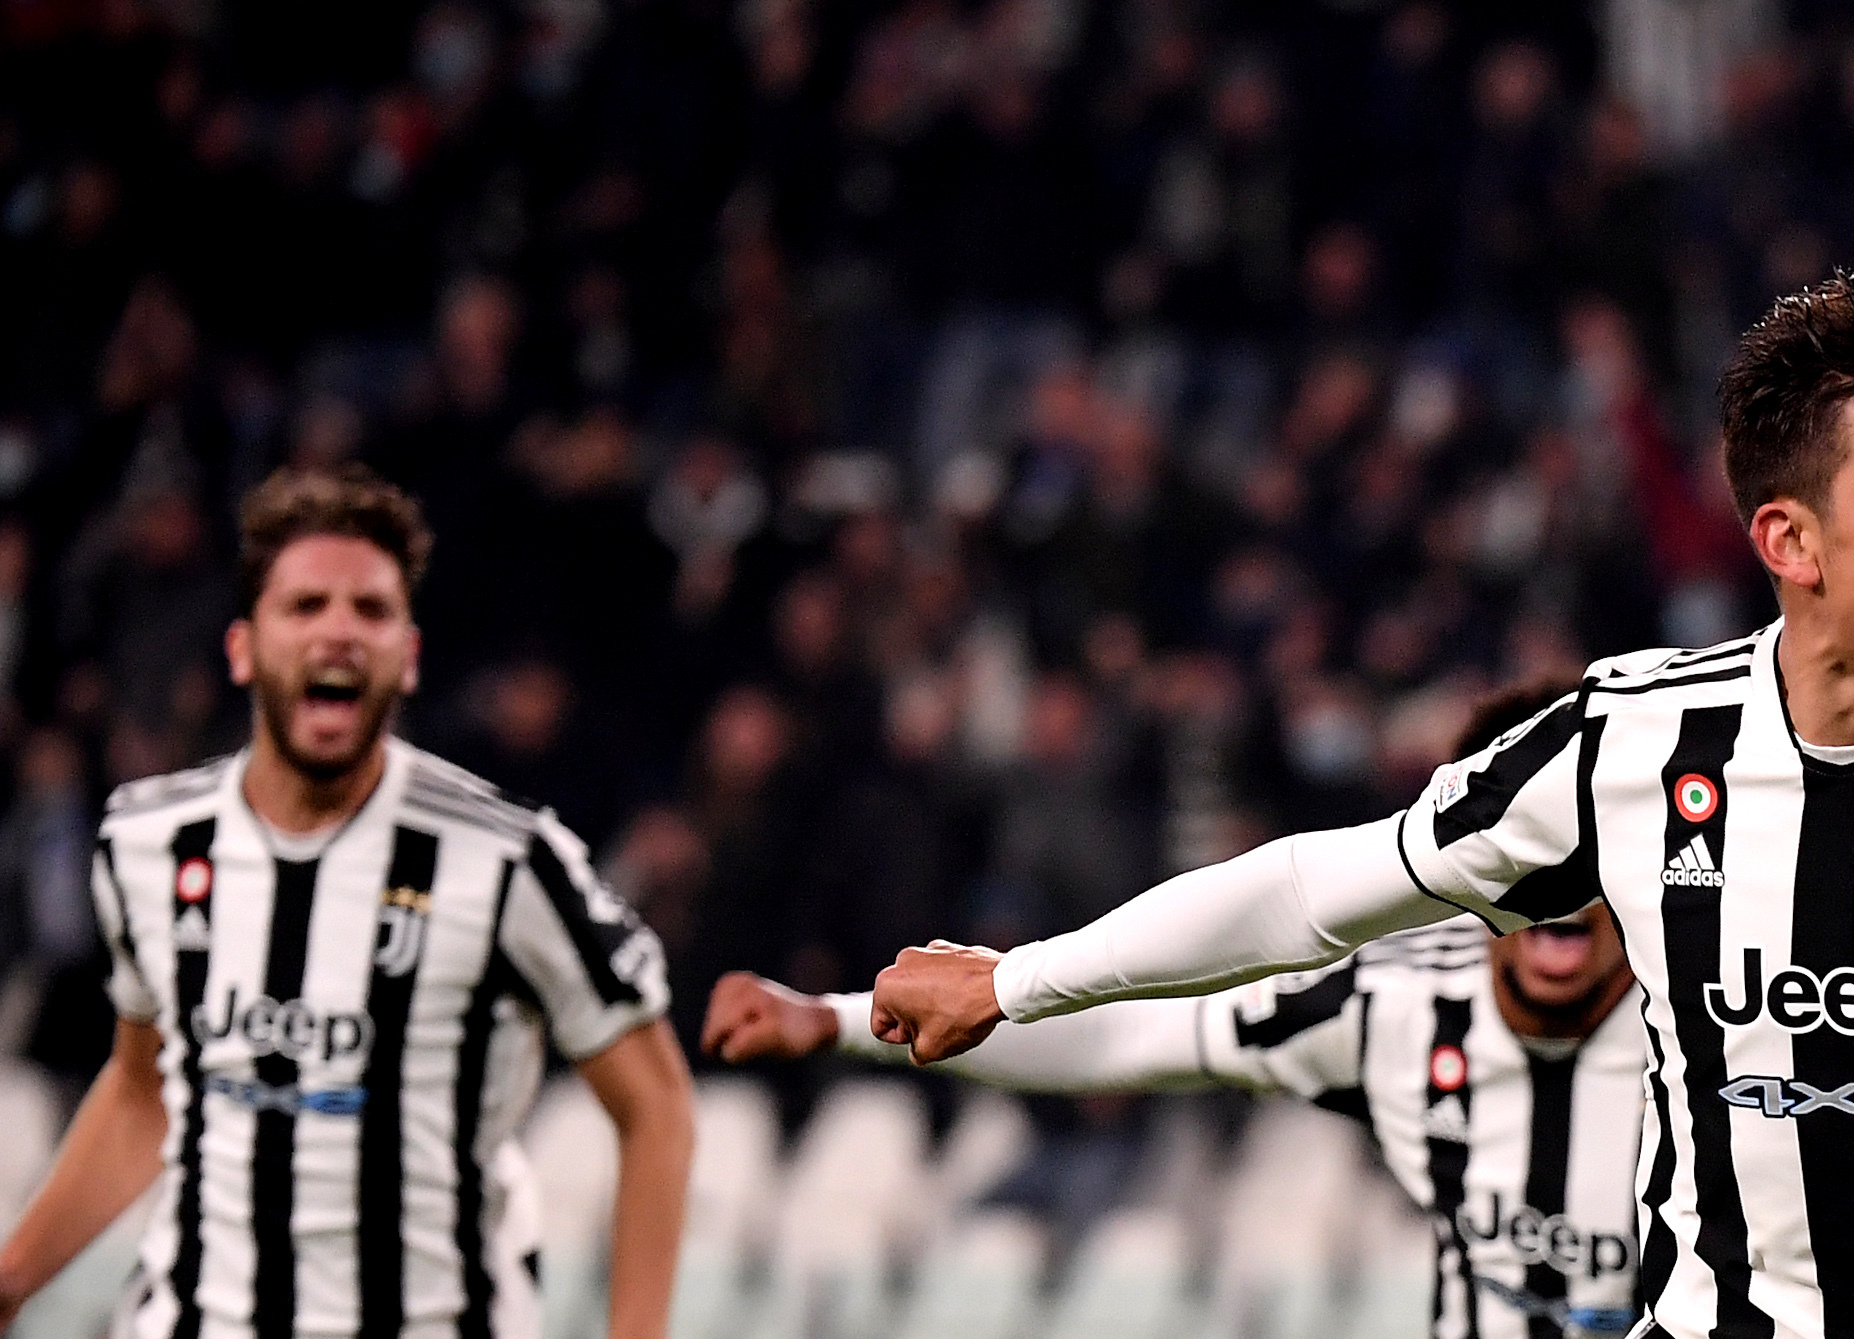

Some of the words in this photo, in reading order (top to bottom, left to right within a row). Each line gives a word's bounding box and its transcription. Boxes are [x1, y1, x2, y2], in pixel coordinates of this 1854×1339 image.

[1660, 867, 1724, 888] adidas
[192, 988, 375, 1060] Jeep
[1457, 1191, 1639, 1276] Jeep
